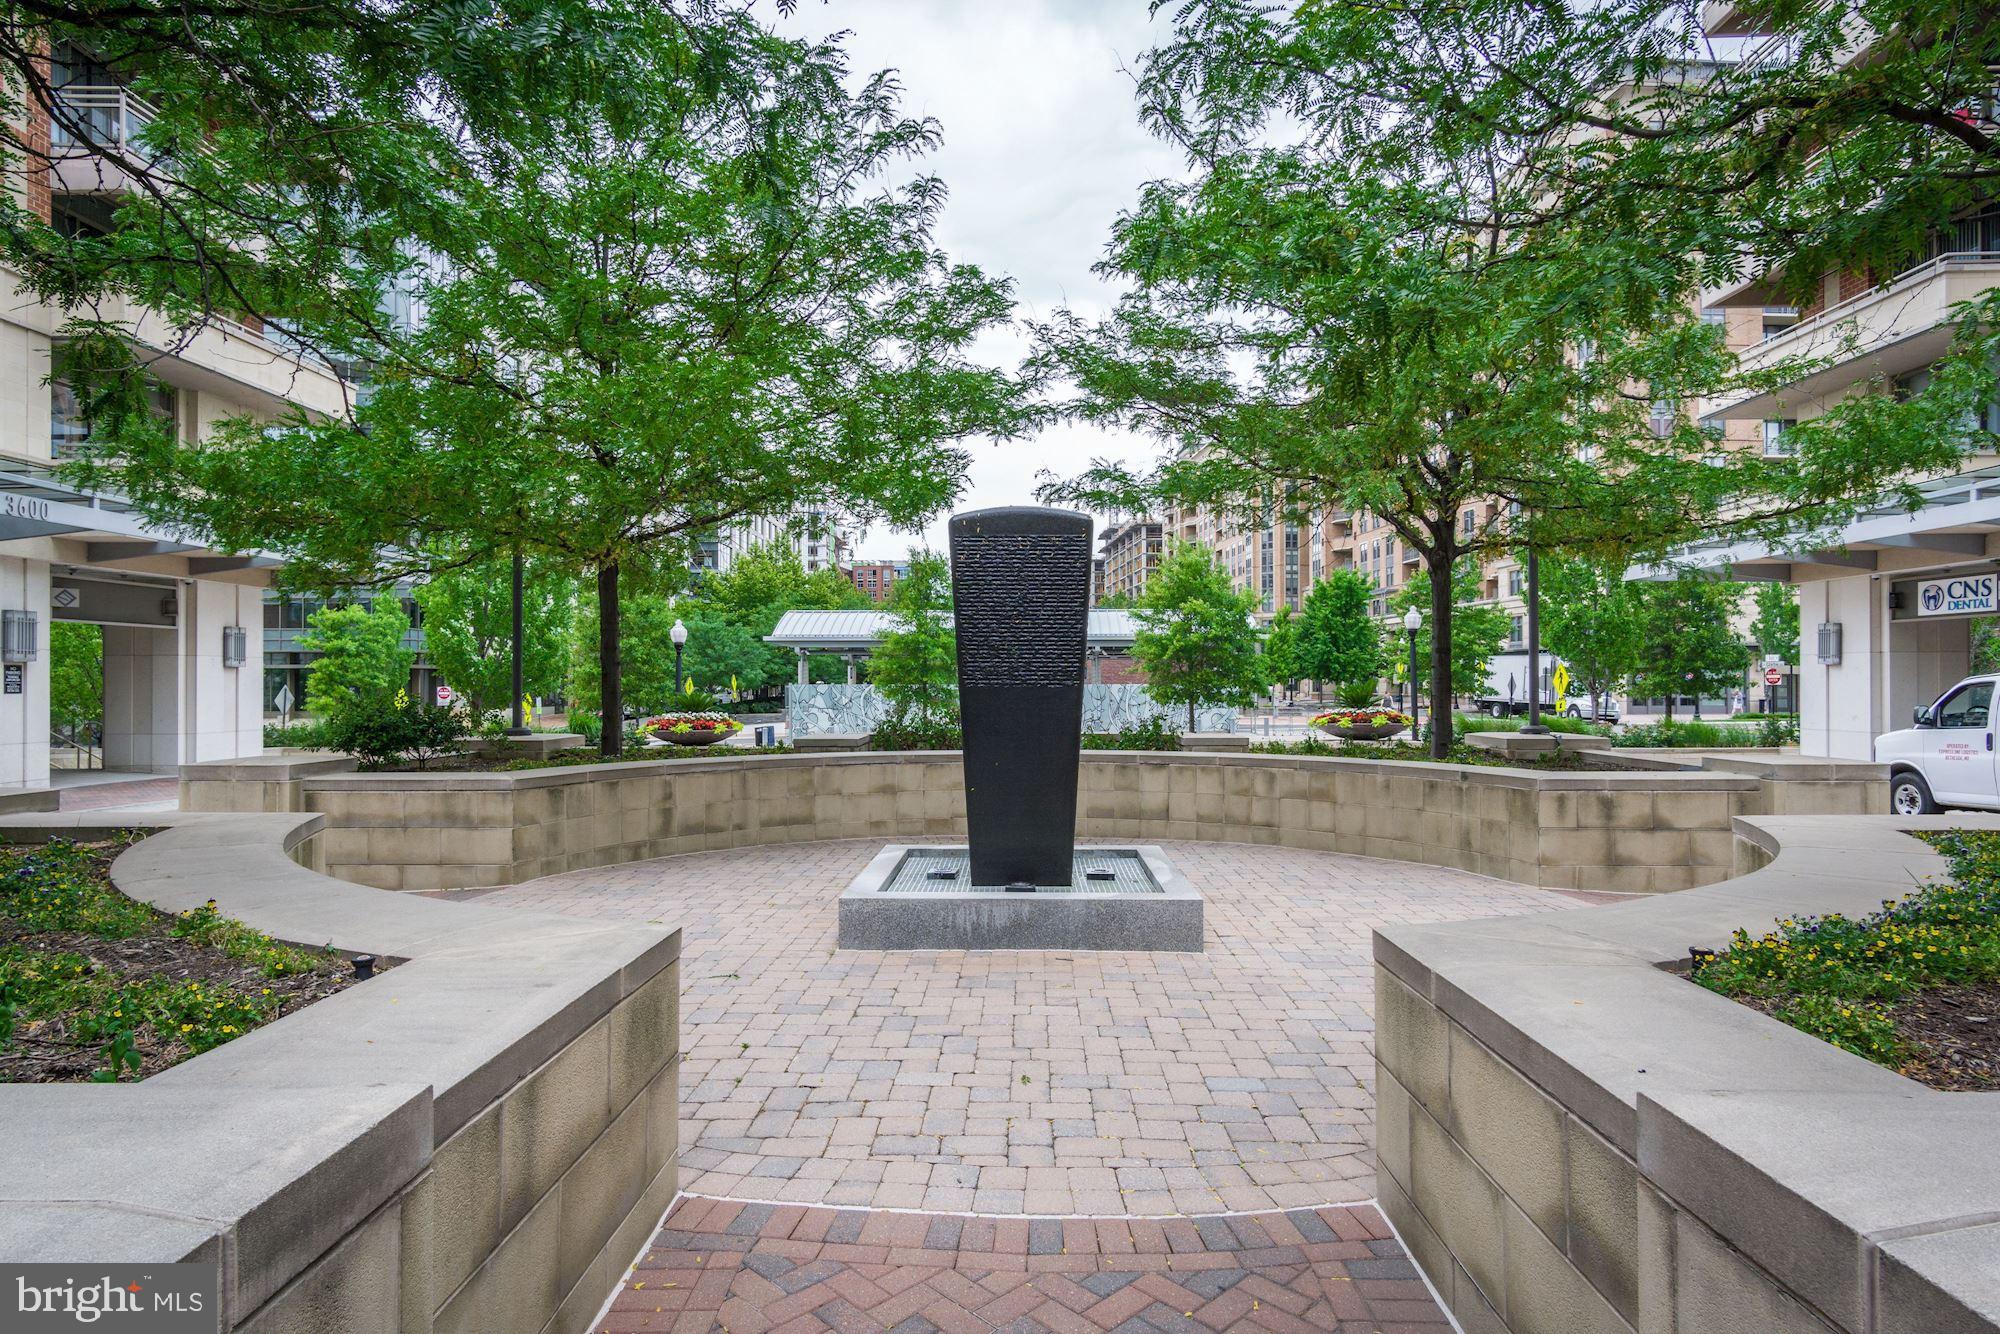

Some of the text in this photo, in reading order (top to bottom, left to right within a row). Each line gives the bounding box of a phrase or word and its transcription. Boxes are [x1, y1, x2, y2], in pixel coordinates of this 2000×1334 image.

[5, 495, 49, 520] 3600
[1947, 578, 1992, 599] CNS
[1948, 598, 1992, 610] DENTAL
